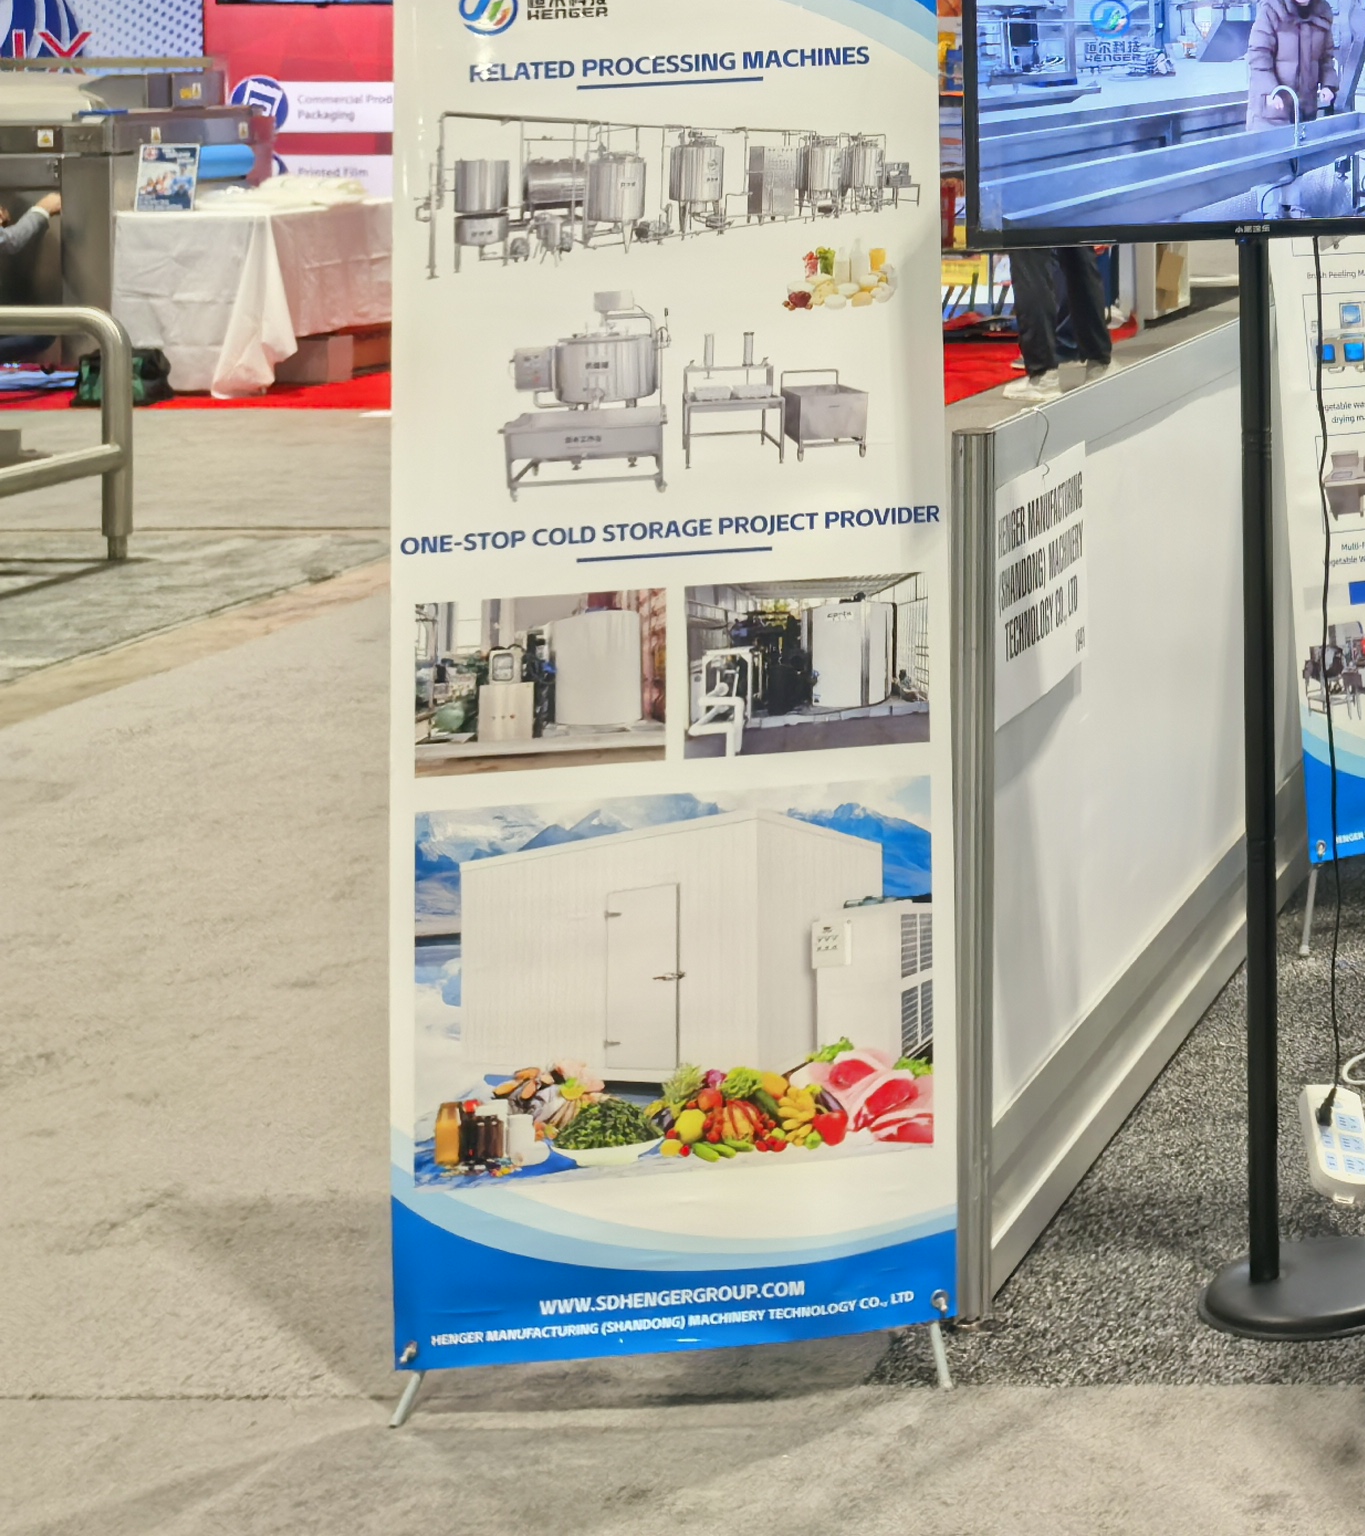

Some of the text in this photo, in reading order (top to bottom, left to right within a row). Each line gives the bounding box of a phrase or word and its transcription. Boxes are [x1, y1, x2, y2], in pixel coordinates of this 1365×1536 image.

[527, 7, 608, 21] HENGER
[469, 46, 870, 83] RELATED PROCESSING MACHINES
[297, 110, 355, 122] Packaging
[298, 167, 368, 177] Printed Film
[1307, 270, 1327, 280] Bruh
[1331, 414, 1355, 425] drying
[400, 505, 940, 556] ONE-STOP COLD STORAGE PROJECT PROVIDER
[998, 471, 1083, 560] HENGER MANUFACTURING
[998, 519, 1083, 618] (SHANDONG) MACHINERY
[1004, 594, 1054, 662] TECHNOLOGY
[1067, 574, 1078, 617] LTD
[1075, 626, 1085, 654] 1941
[539, 1280, 805, 1316] WWW.SDHENGERGROUP.COM
[431, 1331, 484, 1347] HENGER
[486, 1322, 599, 1343] MANUFACTURING
[601, 1314, 686, 1337] (SHANDONG)
[688, 1308, 766, 1328] MACHINERY
[769, 1301, 857, 1321] TECHNOLOGY
[890, 1290, 915, 1305] LTD
